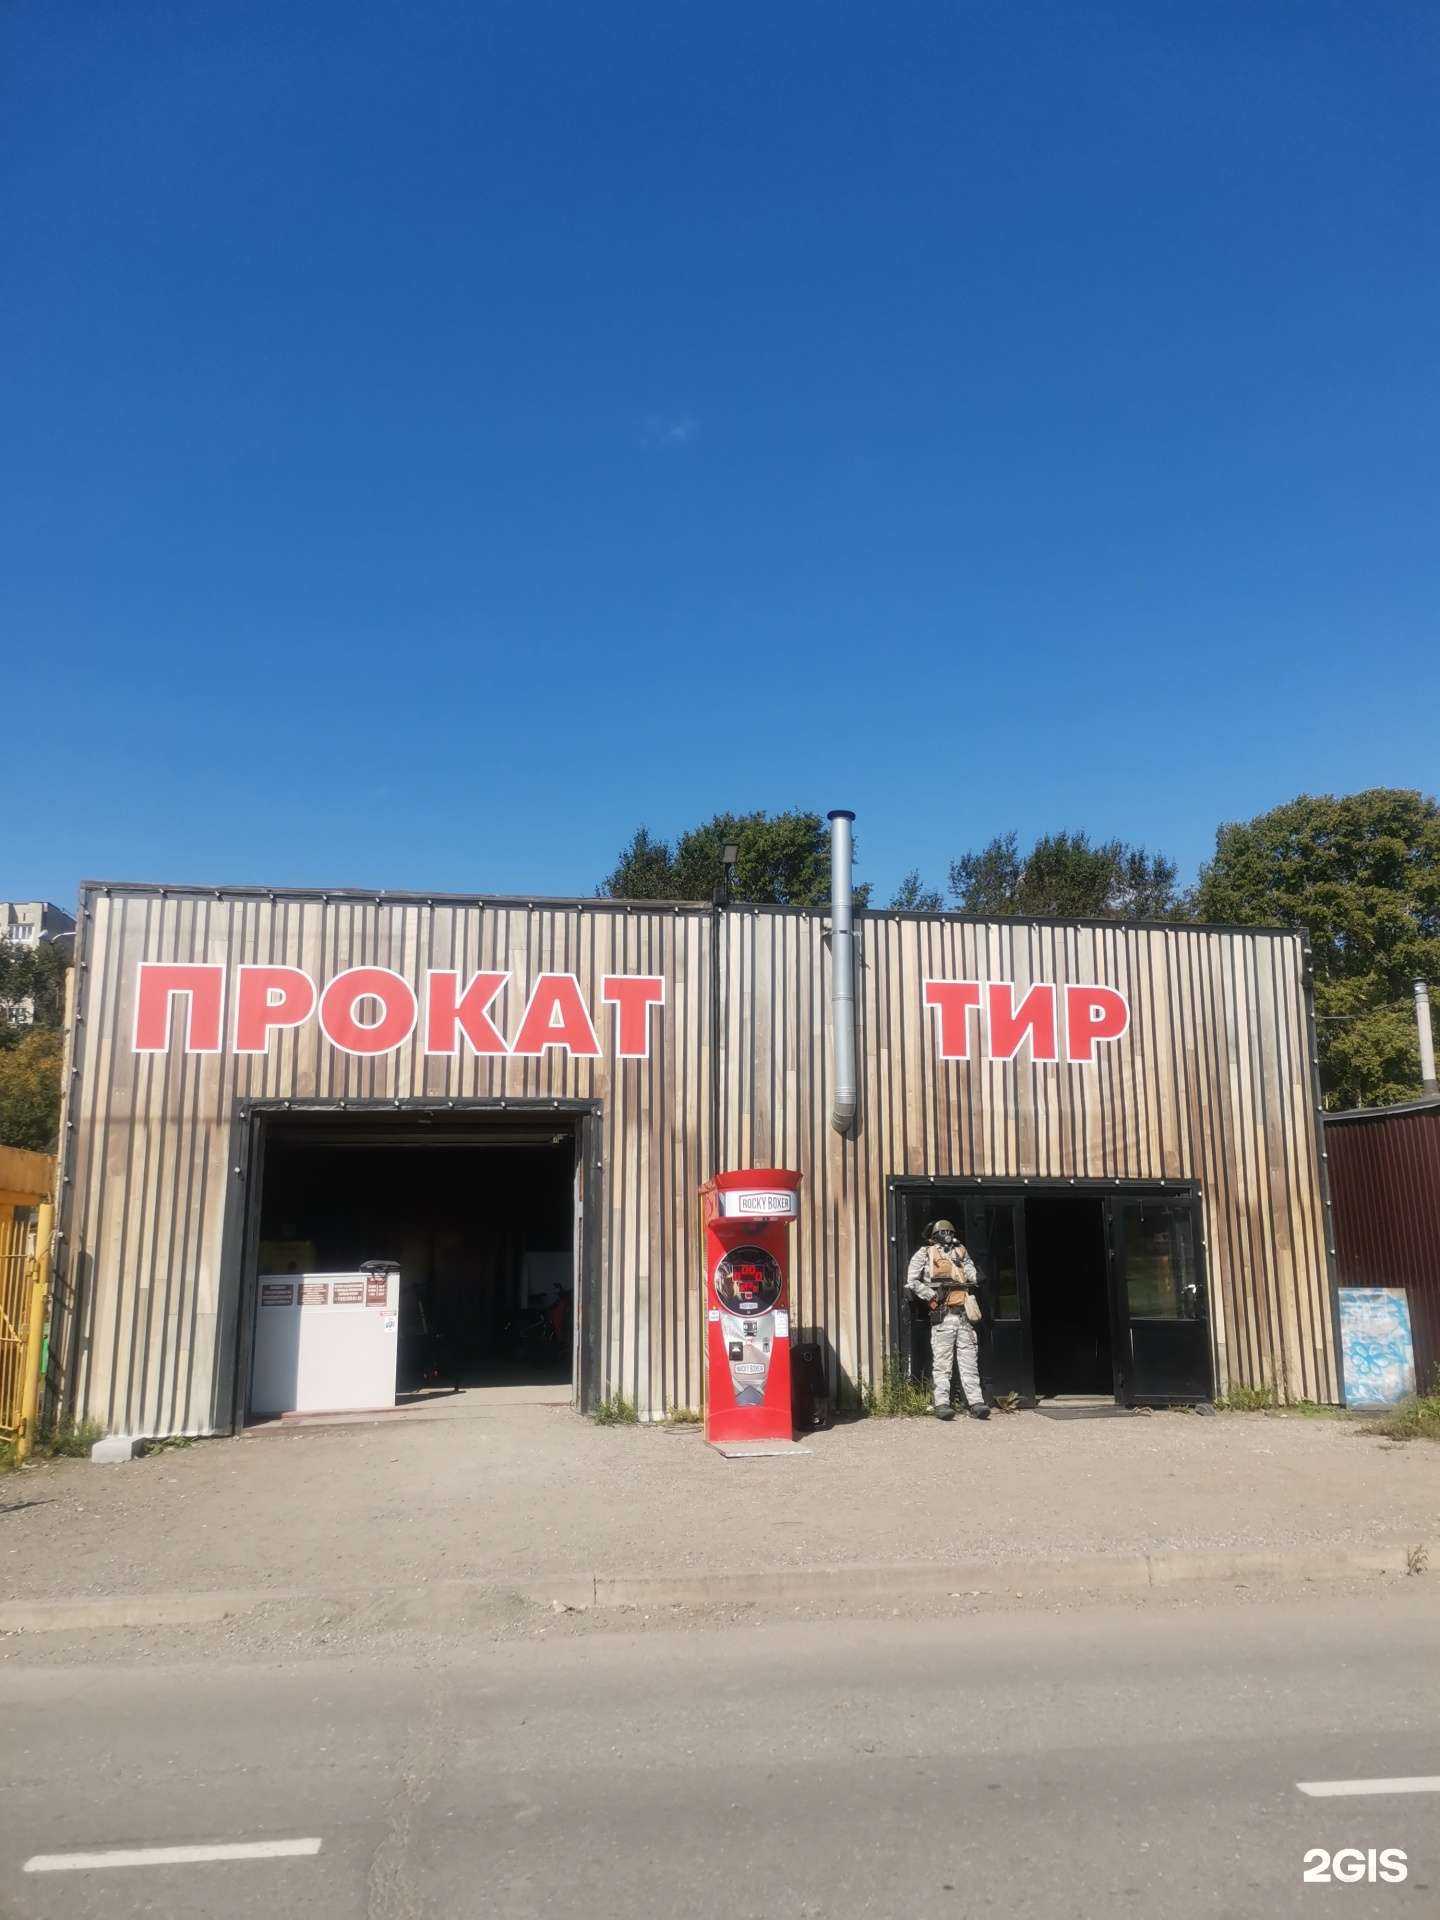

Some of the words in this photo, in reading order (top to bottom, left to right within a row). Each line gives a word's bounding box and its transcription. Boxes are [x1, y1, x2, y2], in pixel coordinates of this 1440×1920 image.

[132, 963, 666, 1057] ПРОКАТ
[922, 980, 1130, 1063] ТИР
[743, 1197, 766, 1209] ROCKY
[768, 1197, 789, 1209] BOXER
